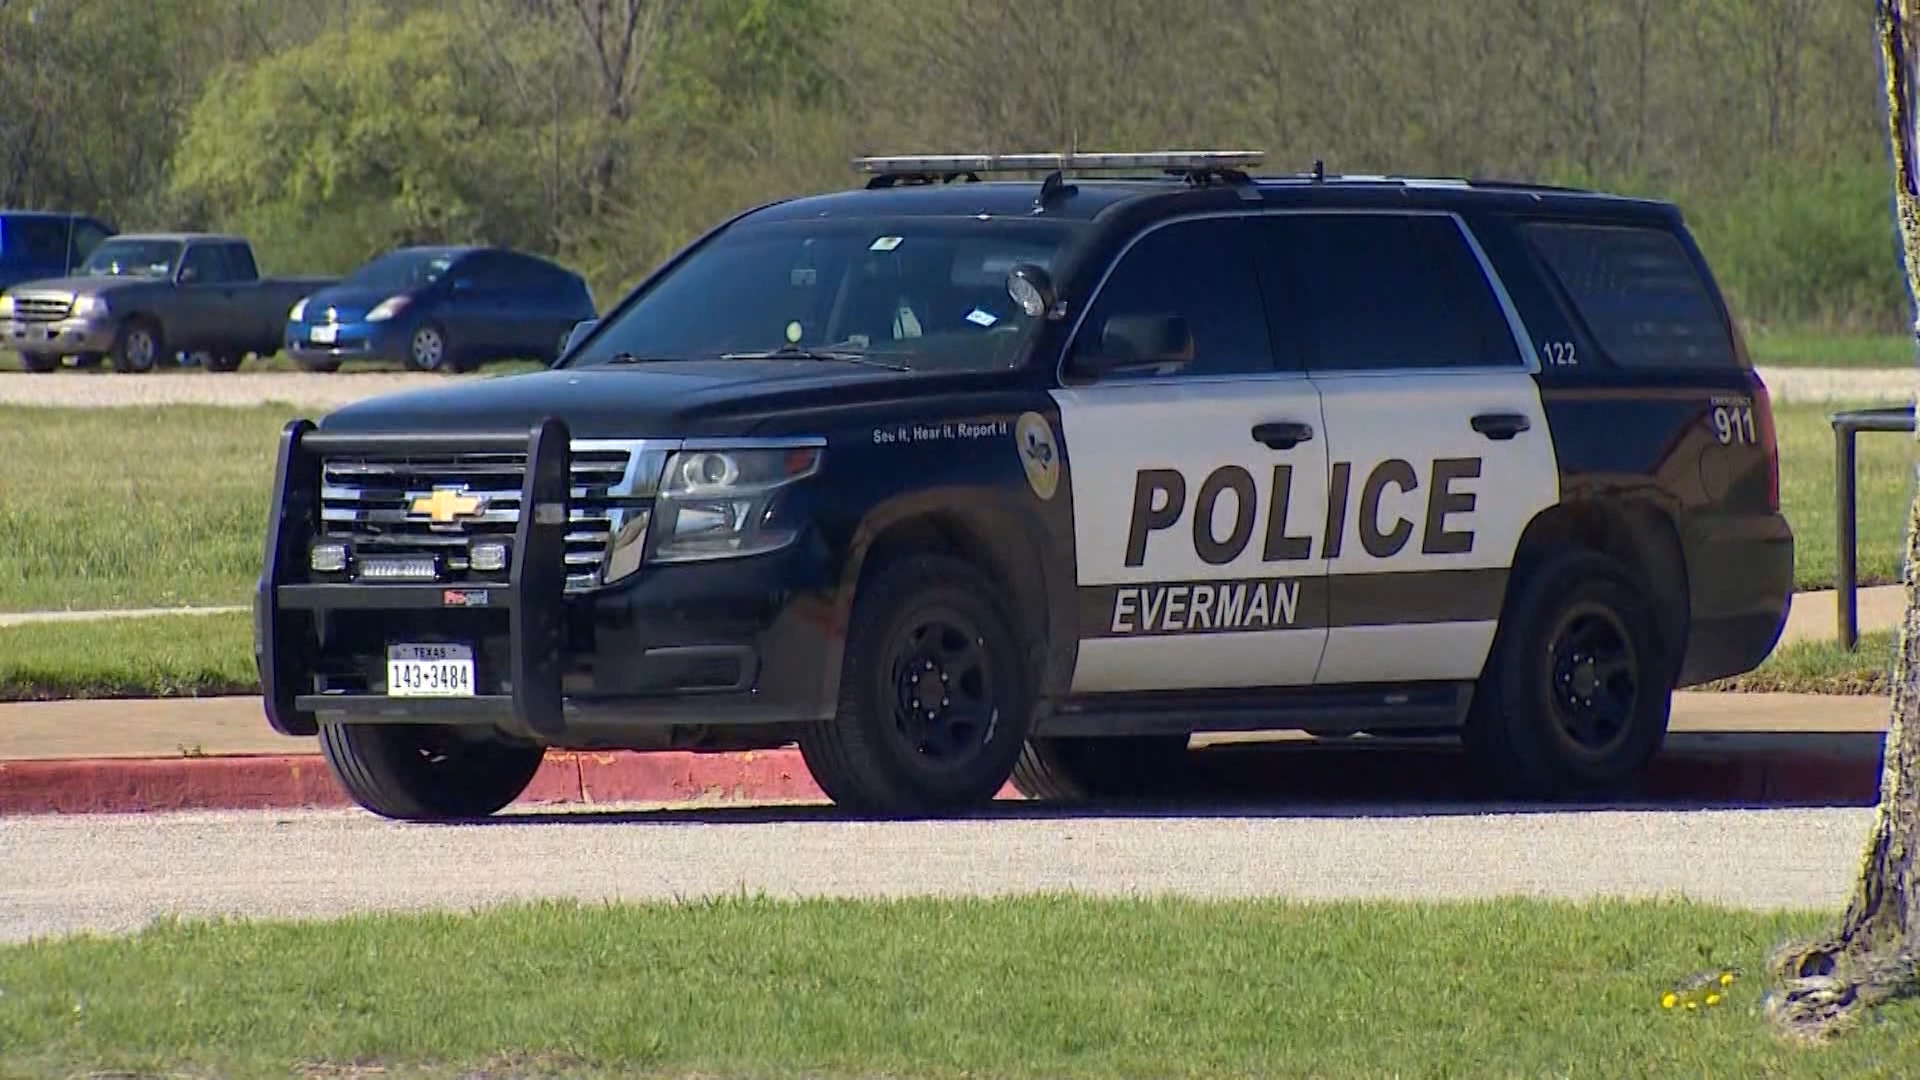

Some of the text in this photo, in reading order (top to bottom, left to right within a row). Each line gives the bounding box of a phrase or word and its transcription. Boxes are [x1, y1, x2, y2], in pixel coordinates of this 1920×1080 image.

[1543, 341, 1578, 365] 122
[873, 429, 895, 444] See
[913, 426, 940, 441] Hear
[958, 422, 996, 438] Report
[999, 420, 1008, 434] it
[1714, 407, 1756, 444] 911
[1124, 457, 1482, 567] POLICE
[1111, 581, 1300, 633] EVERMAN
[413, 647, 446, 658] TEXAS
